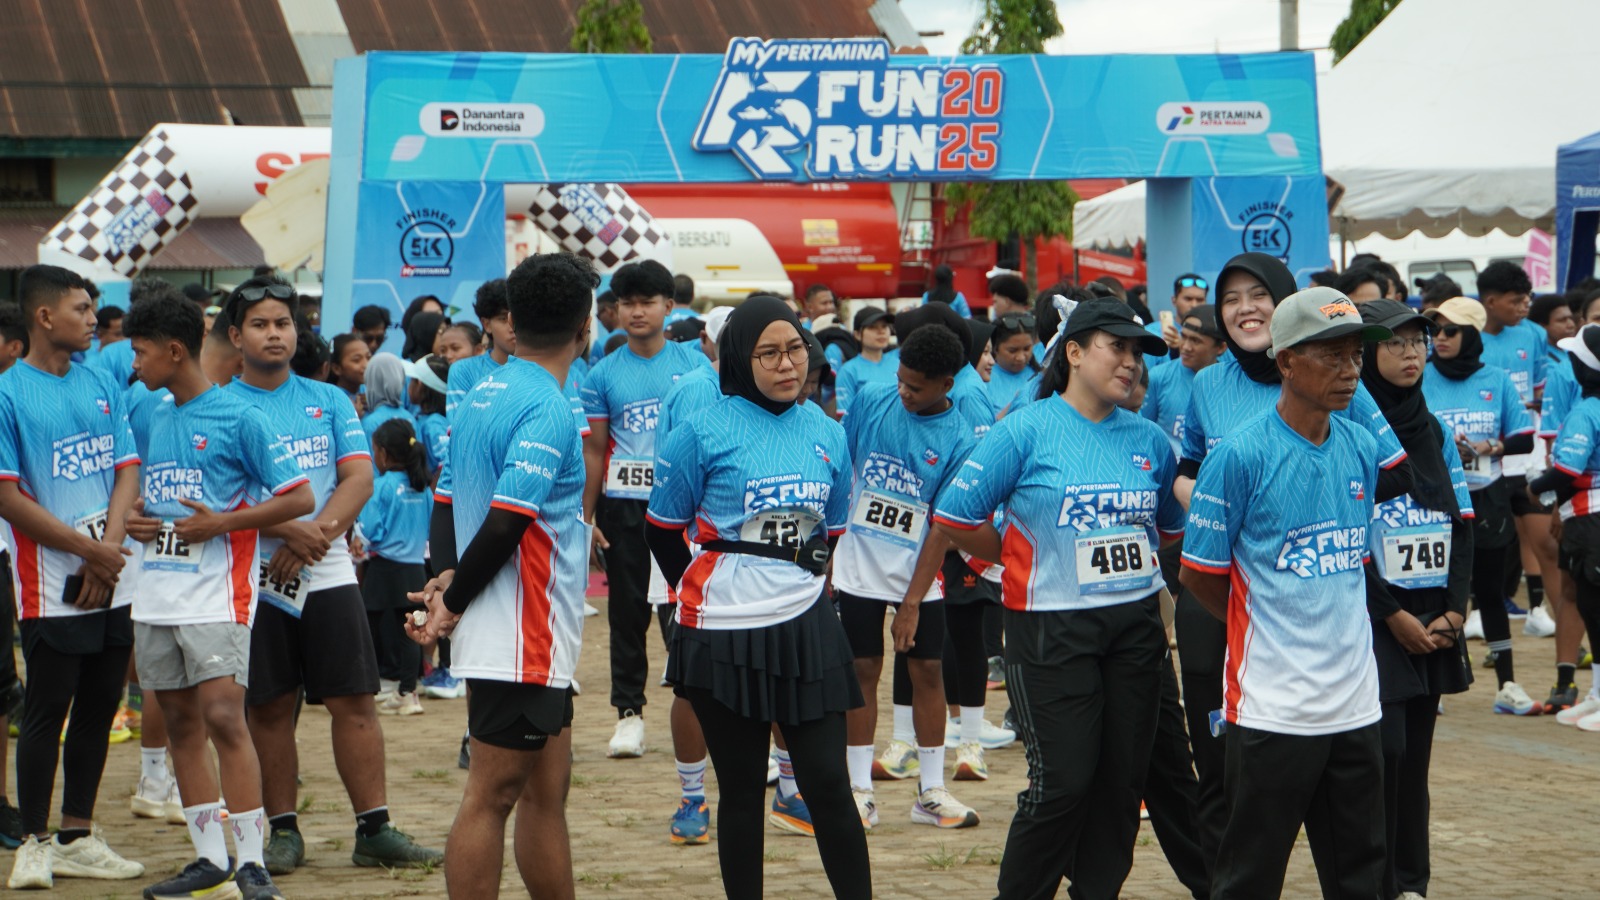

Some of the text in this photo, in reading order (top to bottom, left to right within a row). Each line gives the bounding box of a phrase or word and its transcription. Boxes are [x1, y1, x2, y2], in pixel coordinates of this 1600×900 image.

[732, 43, 886, 70] MyPERTAMINA
[817, 68, 1001, 118] FUN 20
[462, 108, 525, 121] Danantara
[1200, 110, 1263, 120] PERTAMINA
[462, 120, 521, 132] Indonesia
[814, 123, 999, 173] RUN 25
[395, 207, 457, 230] FINISHER
[1238, 201, 1294, 222] FINISHER
[678, 231, 731, 247] BERSATU
[1454, 411, 1482, 423] FUN
[1454, 422, 1482, 435] RUN
[285, 438, 312, 455] UN
[313, 435, 329, 450] 20
[313, 450, 329, 467] 25
[515, 460, 542, 475] Bright
[1132, 454, 1147, 465] My
[617, 467, 654, 487] 459
[746, 473, 802, 490] MyPERTAMINA
[779, 482, 820, 502] FUN
[1065, 482, 1121, 496] MyPERTAMINA
[1097, 491, 1142, 511] FUN
[865, 500, 914, 534] 284
[1189, 512, 1211, 528] Bright
[1350, 527, 1366, 547] 20
[1091, 542, 1143, 575] 488
[1398, 541, 1445, 572] 748
